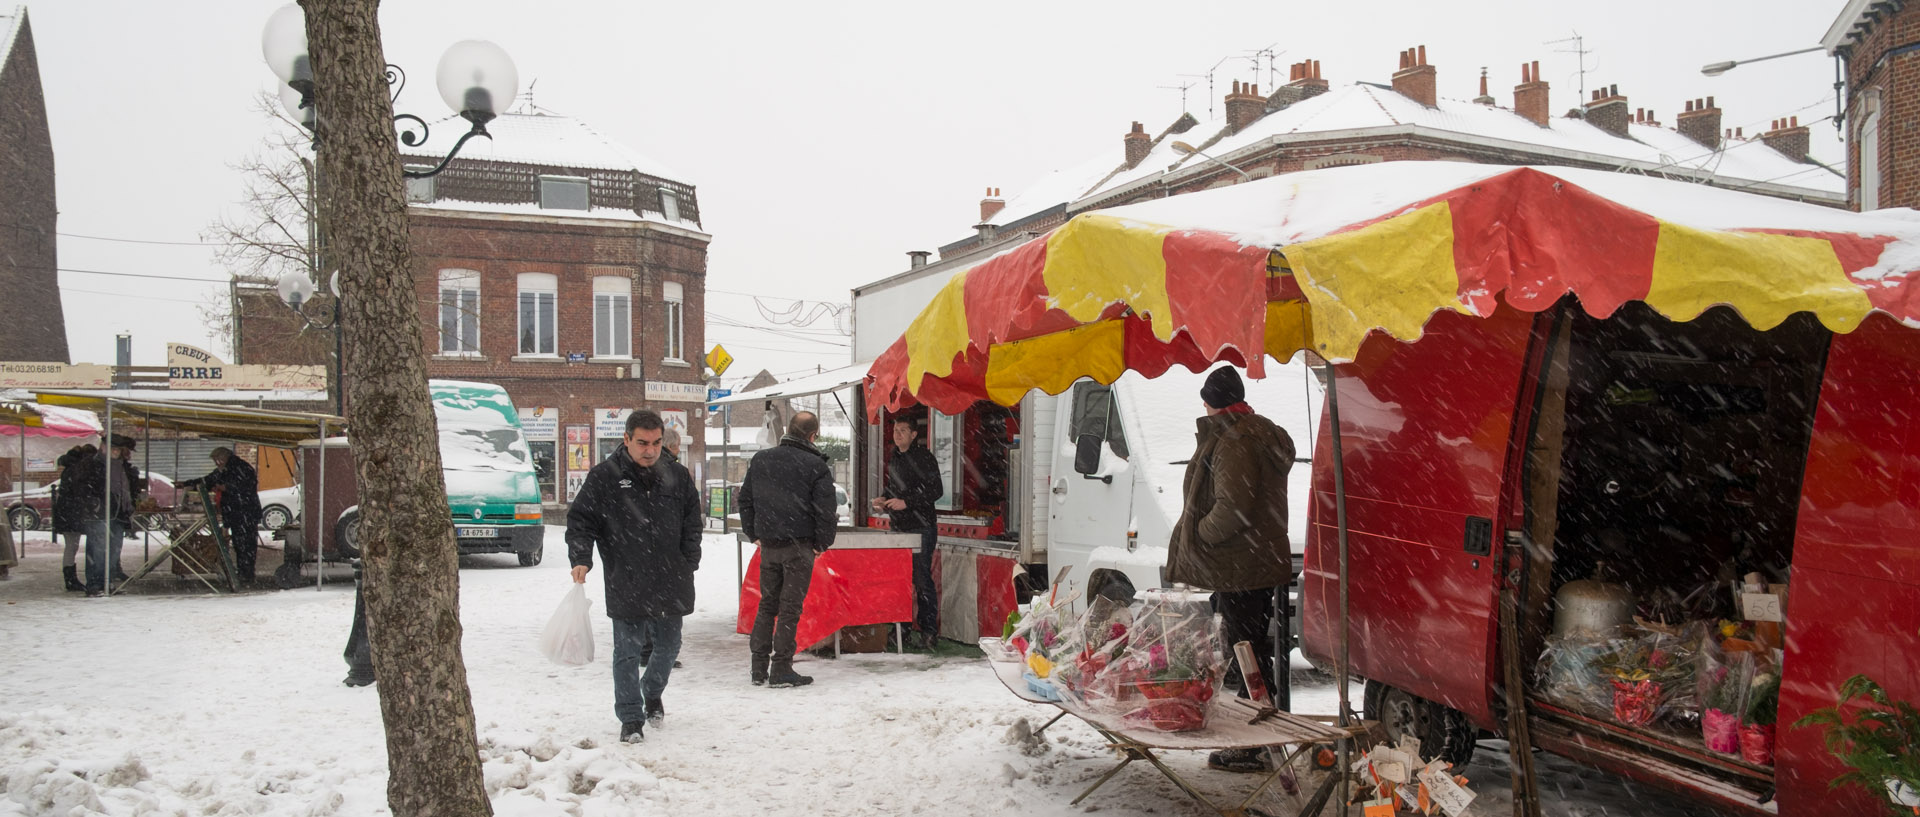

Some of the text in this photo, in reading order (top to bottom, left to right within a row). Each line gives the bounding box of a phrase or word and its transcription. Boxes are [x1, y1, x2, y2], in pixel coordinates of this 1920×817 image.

[175, 345, 211, 364] CREUX
[715, 357, 729, 373] PRESSE
[3, 378, 84, 387] Restauration
[647, 383, 667, 392] TOUTE
[684, 386, 705, 394] PRESSE
[1751, 599, 1777, 618] 5€
